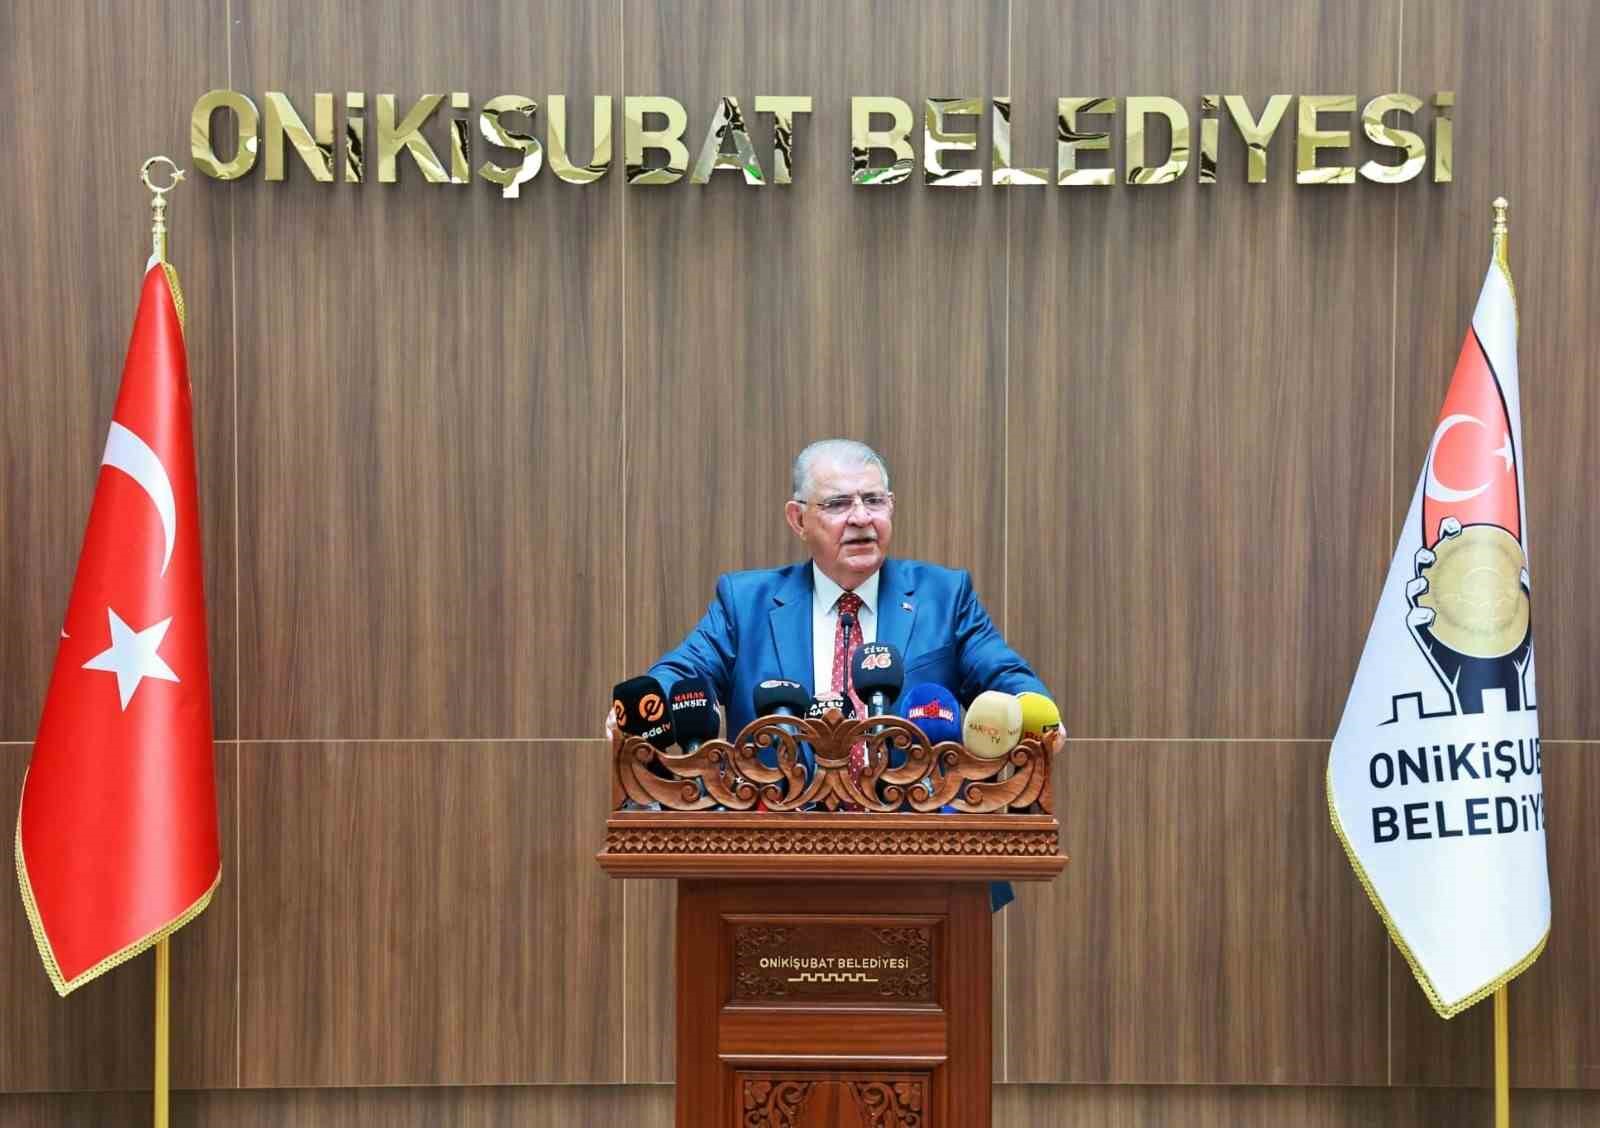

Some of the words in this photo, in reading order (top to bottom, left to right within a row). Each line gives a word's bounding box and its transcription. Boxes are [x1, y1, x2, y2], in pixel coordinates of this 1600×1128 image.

[190, 89, 813, 199] ONİKİŞUBAT
[850, 91, 1455, 187] BELEDİYESİ
[1371, 793, 1546, 844] BELEDİY
[759, 956, 834, 971] ONİKİŞUBAT
[838, 957, 909, 969] BELEDİYESİ
